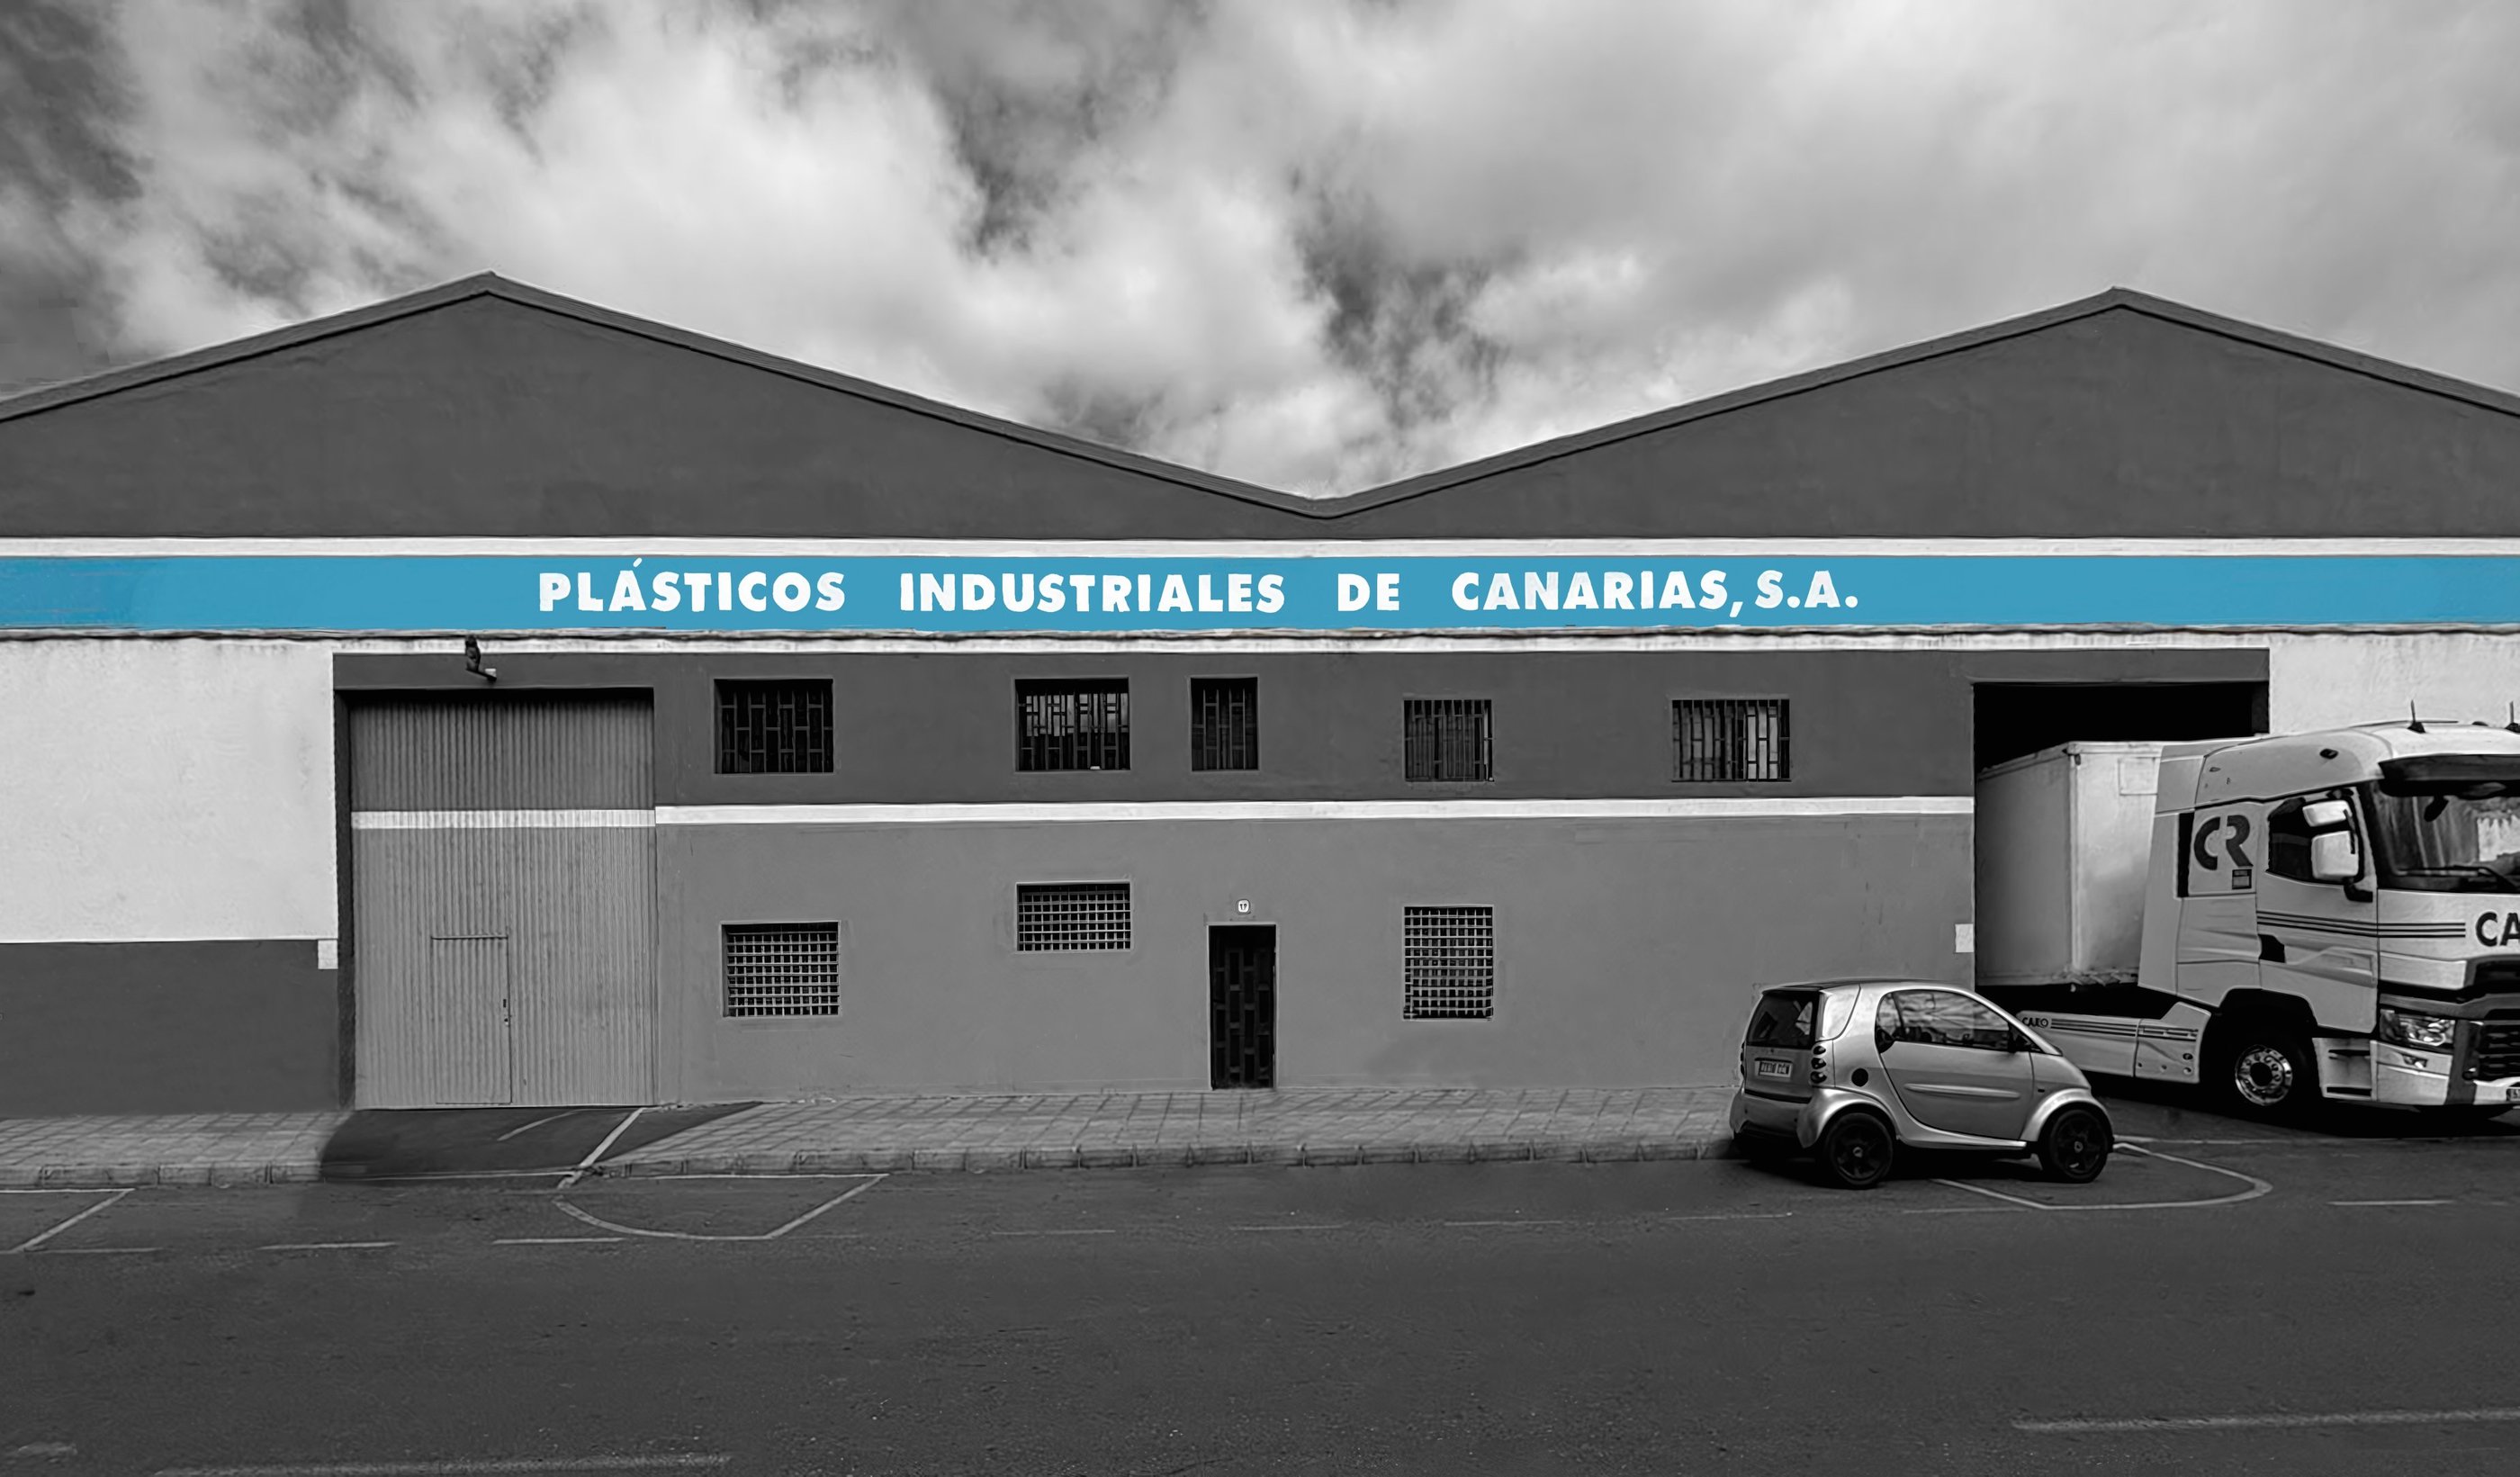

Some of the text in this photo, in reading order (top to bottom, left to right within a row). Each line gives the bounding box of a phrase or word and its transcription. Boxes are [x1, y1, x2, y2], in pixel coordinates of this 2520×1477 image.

[539, 557, 845, 612] PLÁSTICOS
[900, 572, 1285, 614] INDUSTRIALES
[1337, 572, 1400, 612] DE
